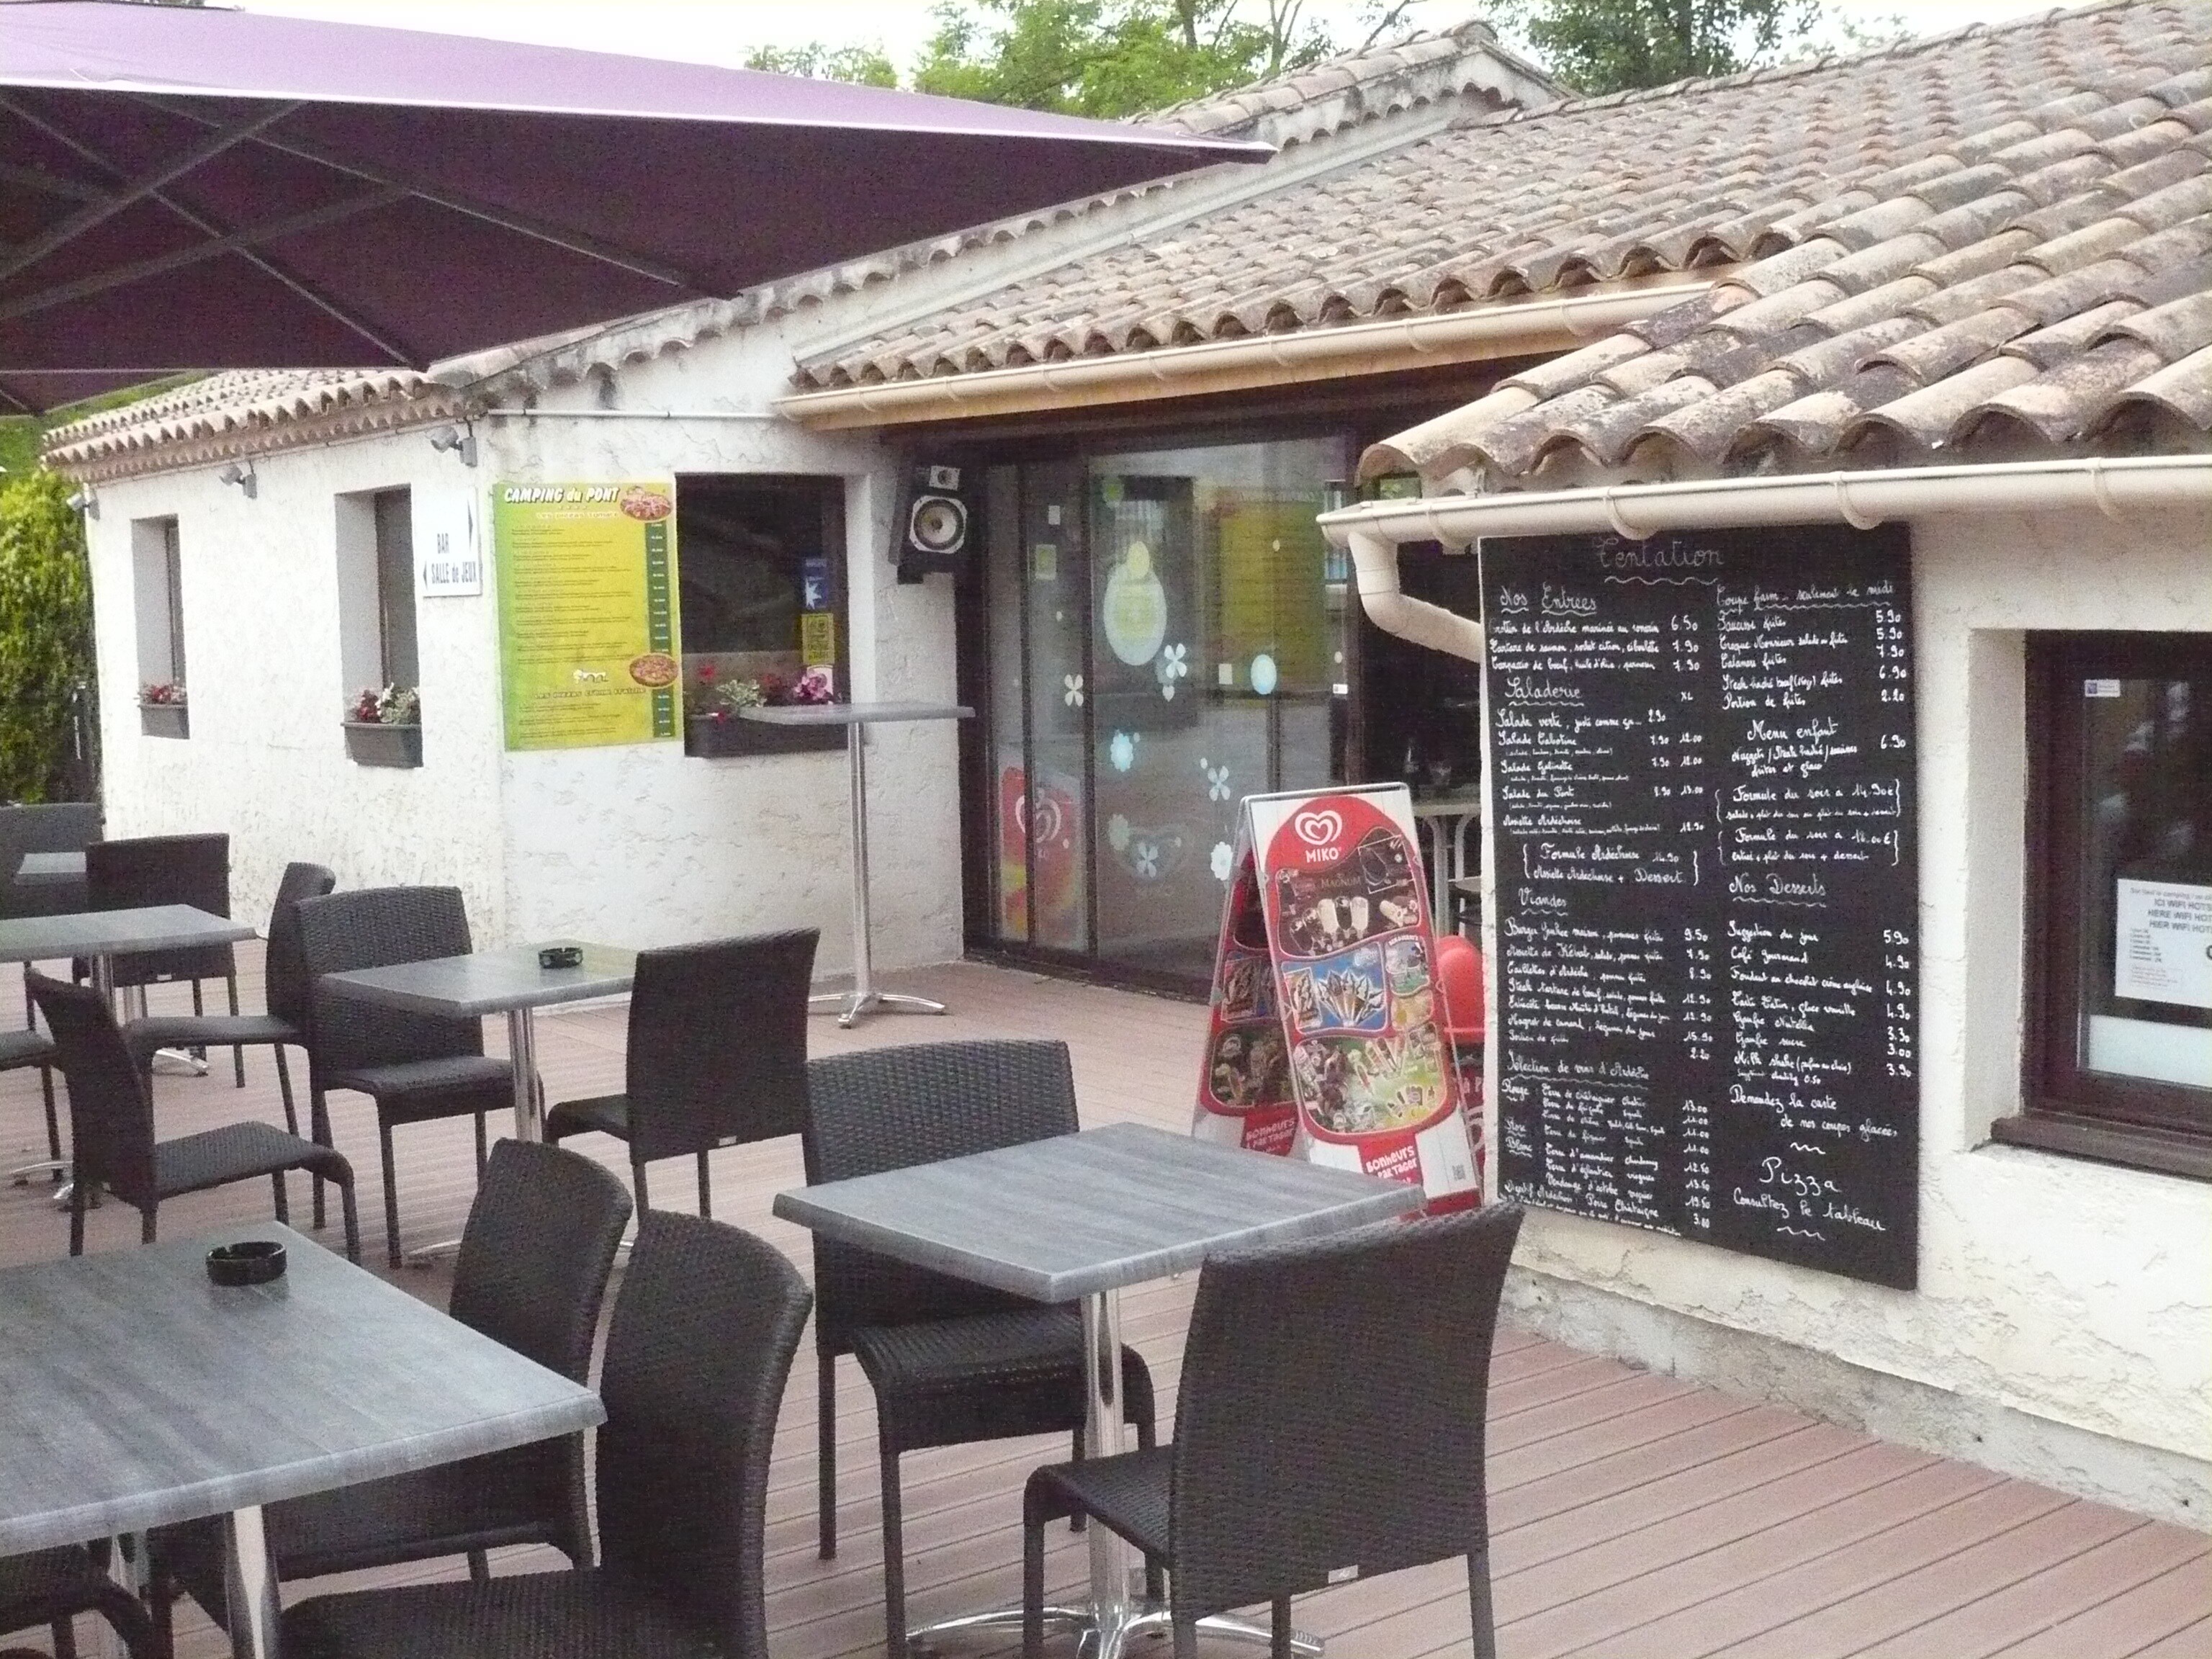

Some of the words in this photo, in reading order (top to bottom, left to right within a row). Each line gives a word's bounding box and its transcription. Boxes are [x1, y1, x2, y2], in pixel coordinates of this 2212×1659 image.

[504, 487, 564, 503] CAMPING
[567, 488, 583, 503] du
[586, 487, 619, 503] PONT
[437, 533, 449, 554] BAR
[432, 563, 449, 584] SALLE
[462, 562, 477, 583] JEUX
[1866, 580, 1893, 595] midi
[1875, 609, 1901, 624] 5.90
[1876, 626, 1902, 640] 5.90
[1875, 644, 1904, 658] 7.90
[1504, 675, 1583, 701] Saladerie
[1680, 691, 1694, 702] XL
[1722, 692, 1757, 711] Portion
[1881, 688, 1905, 703] 2.20
[1498, 732, 1532, 746] Salade
[1650, 734, 1669, 746] 7.90
[1679, 732, 1703, 744] 12.00
[1747, 719, 1789, 741] Menu
[1796, 716, 1839, 746] enfant
[1501, 760, 1532, 773] Salade
[1652, 757, 1671, 768] 7.90
[1679, 756, 1703, 767] 12.00
[1501, 786, 1531, 801] Salade
[1680, 785, 1704, 797] 13.00
[1732, 783, 1777, 802] Formule
[1784, 787, 1799, 799] du
[1807, 787, 1831, 799] soir
[1735, 827, 1776, 844] Formule
[1784, 830, 1799, 840] du
[1806, 831, 1828, 840] soir
[1305, 846, 1339, 863] MIKO
[1540, 842, 1586, 860] Formule
[1634, 866, 1684, 884] Dessert
[1729, 872, 1757, 894] Nos
[1765, 872, 1826, 896] Desserts
[1518, 886, 1567, 908] Viandes
[2148, 909, 2171, 919] HERE
[1883, 929, 1910, 945] 5.90
[1761, 948, 1809, 964] gourmand
[1885, 954, 1910, 969] 4.90
[1730, 965, 1768, 982] Fondant
[1885, 979, 1911, 997] 4.90
[1887, 1003, 1911, 1020] 4.90
[1683, 1031, 1714, 1043] 15.90
[1774, 1016, 1815, 1033] Nutella
[1887, 1025, 1910, 1043] 3.30
[1887, 1043, 1912, 1058] 3.00
[1886, 1062, 1912, 1077] 3.90
[1729, 1084, 1785, 1113] Demandez
[1789, 1092, 1804, 1107] la
[1810, 1094, 1838, 1110] carte
[1780, 1112, 1794, 1128] de
[1799, 1120, 1815, 1129] nos
[1822, 1120, 1851, 1138] coupes
[1858, 1118, 1898, 1142] glacées
[1759, 1156, 1843, 1196] Pizza
[1733, 1187, 1789, 1218] Consultez
[1799, 1200, 1812, 1217] le
[1822, 1202, 1887, 1231] tableau
